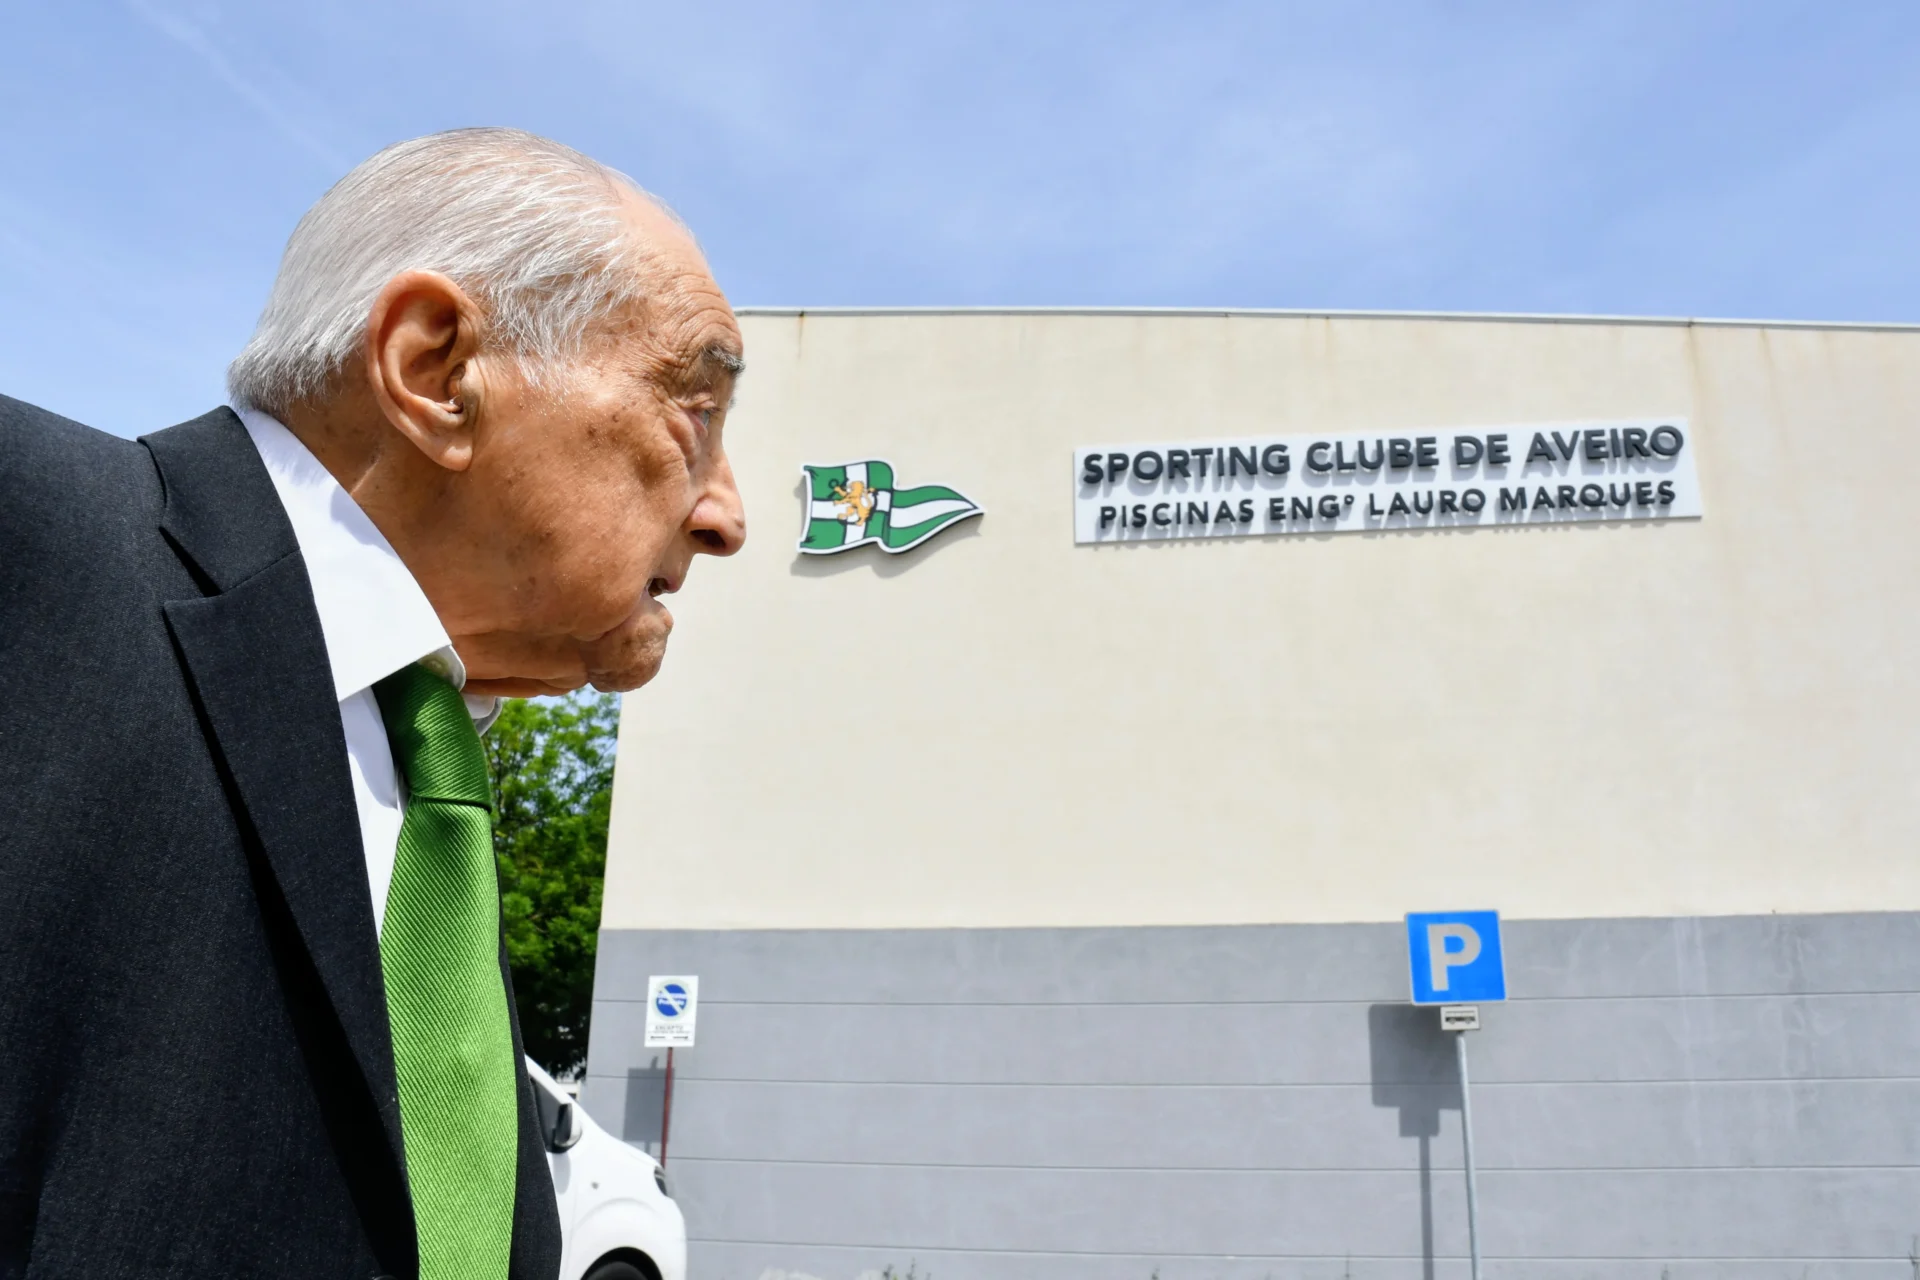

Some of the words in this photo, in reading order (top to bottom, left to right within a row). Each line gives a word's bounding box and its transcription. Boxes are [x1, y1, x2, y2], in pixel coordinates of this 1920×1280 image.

[1083, 443, 1291, 484] SPORTING
[1306, 436, 1439, 472] CLUBE
[1454, 434, 1511, 466] DE
[1526, 425, 1684, 462] AVEIRO
[1100, 499, 1255, 529] PISCINAS
[1369, 488, 1486, 516] LAURO
[1499, 481, 1676, 511] MARQUES
[1427, 923, 1481, 991] P
